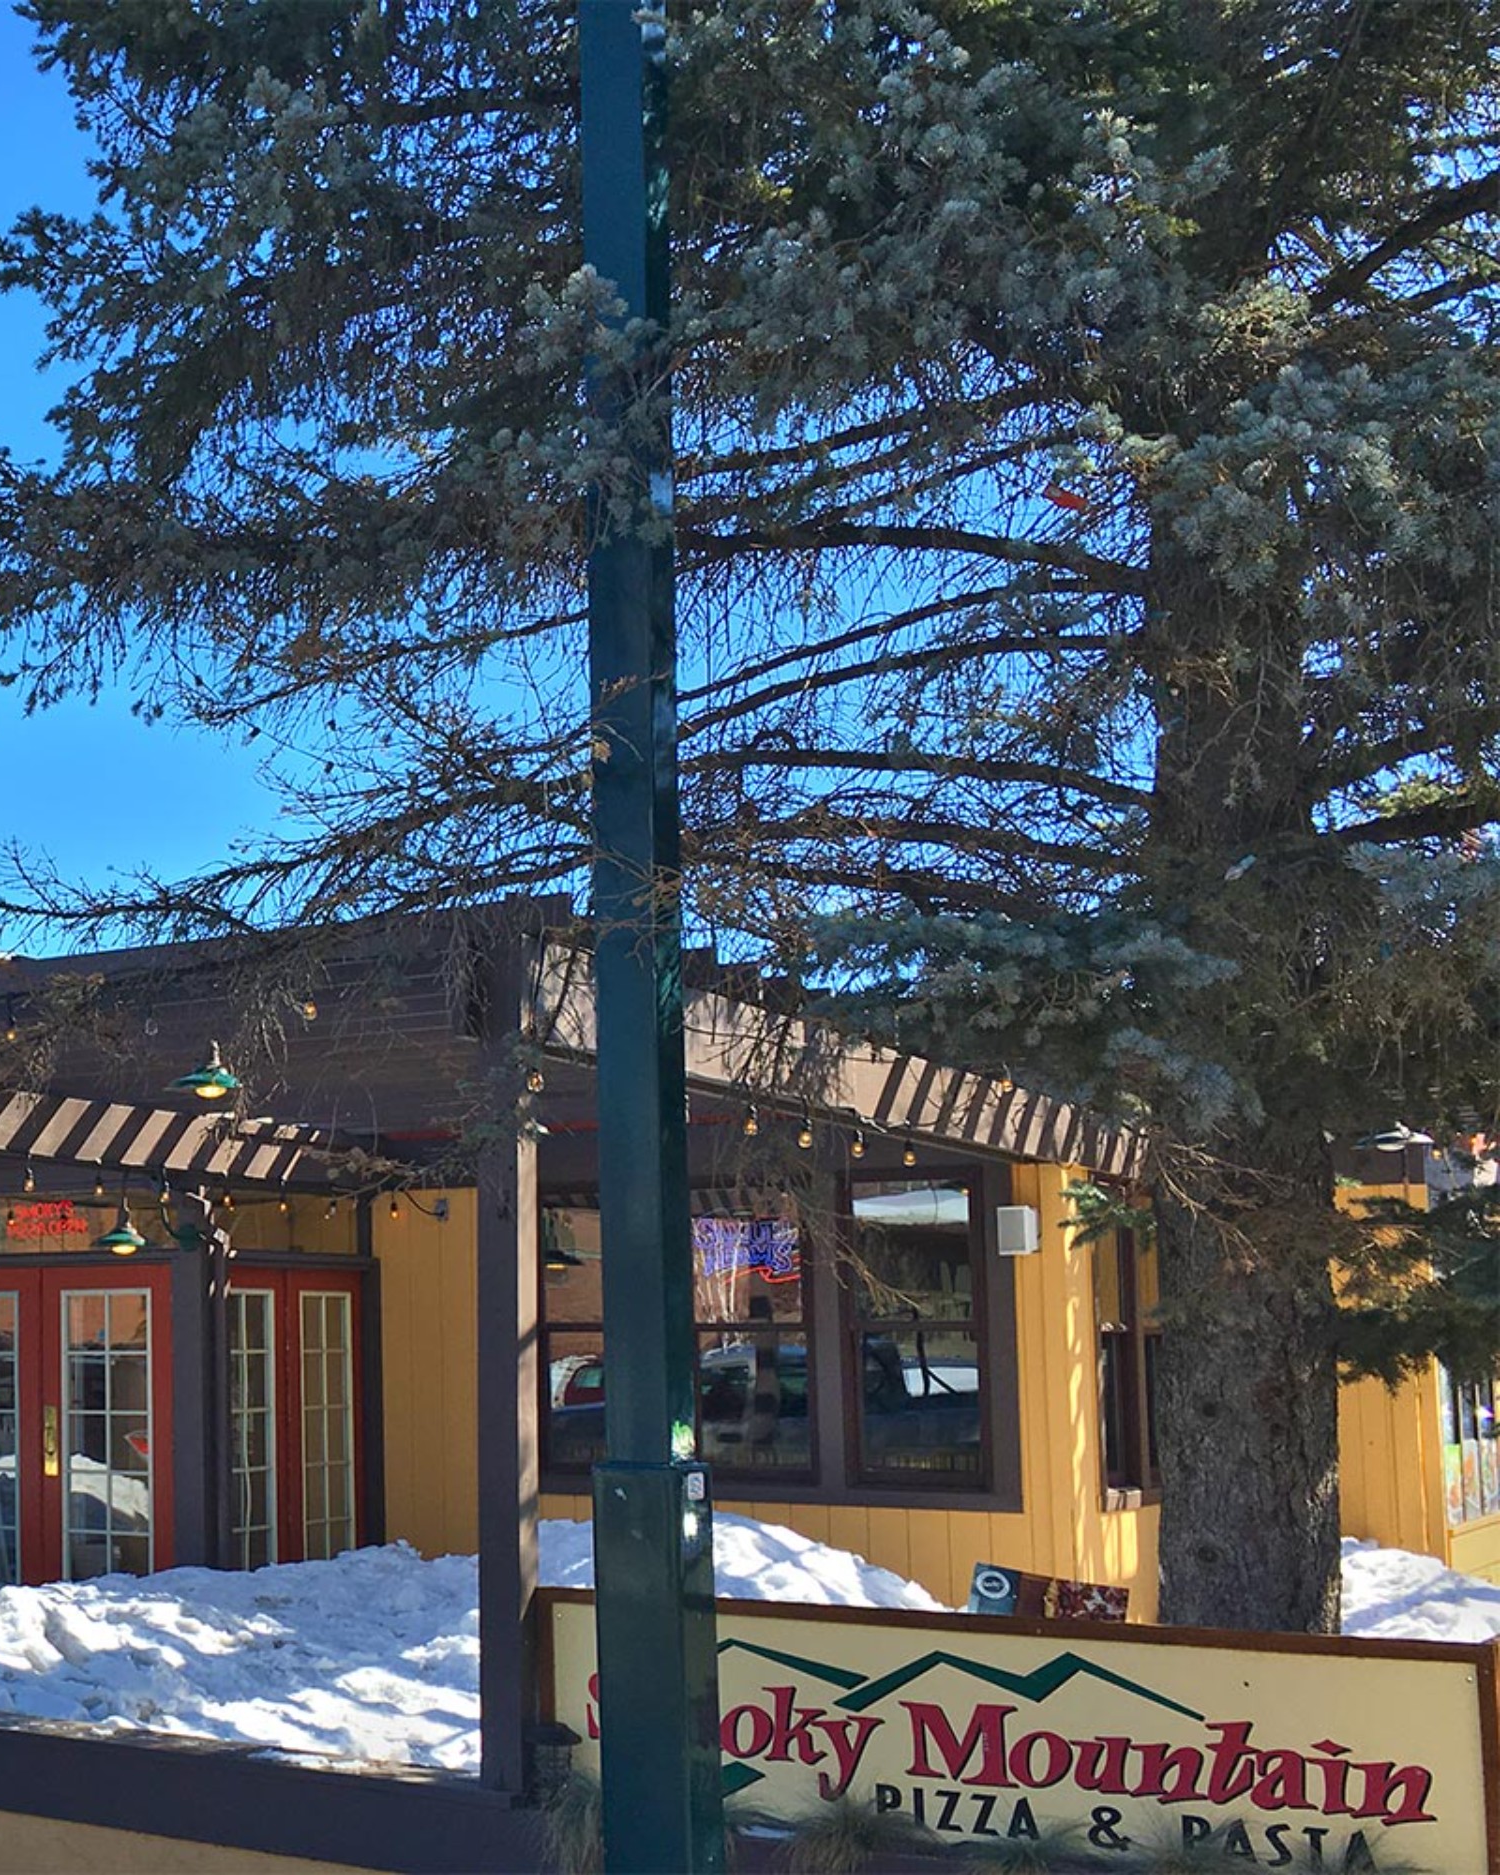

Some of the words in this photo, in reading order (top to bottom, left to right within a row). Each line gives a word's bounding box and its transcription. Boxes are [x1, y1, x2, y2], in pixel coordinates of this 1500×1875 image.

[586, 1672, 886, 1801] oky
[898, 1700, 1438, 1826] Mountain
[875, 1783, 1041, 1841] PIZZA
[1087, 1805, 1132, 1851] &
[1181, 1814, 1378, 1875] PASTA
